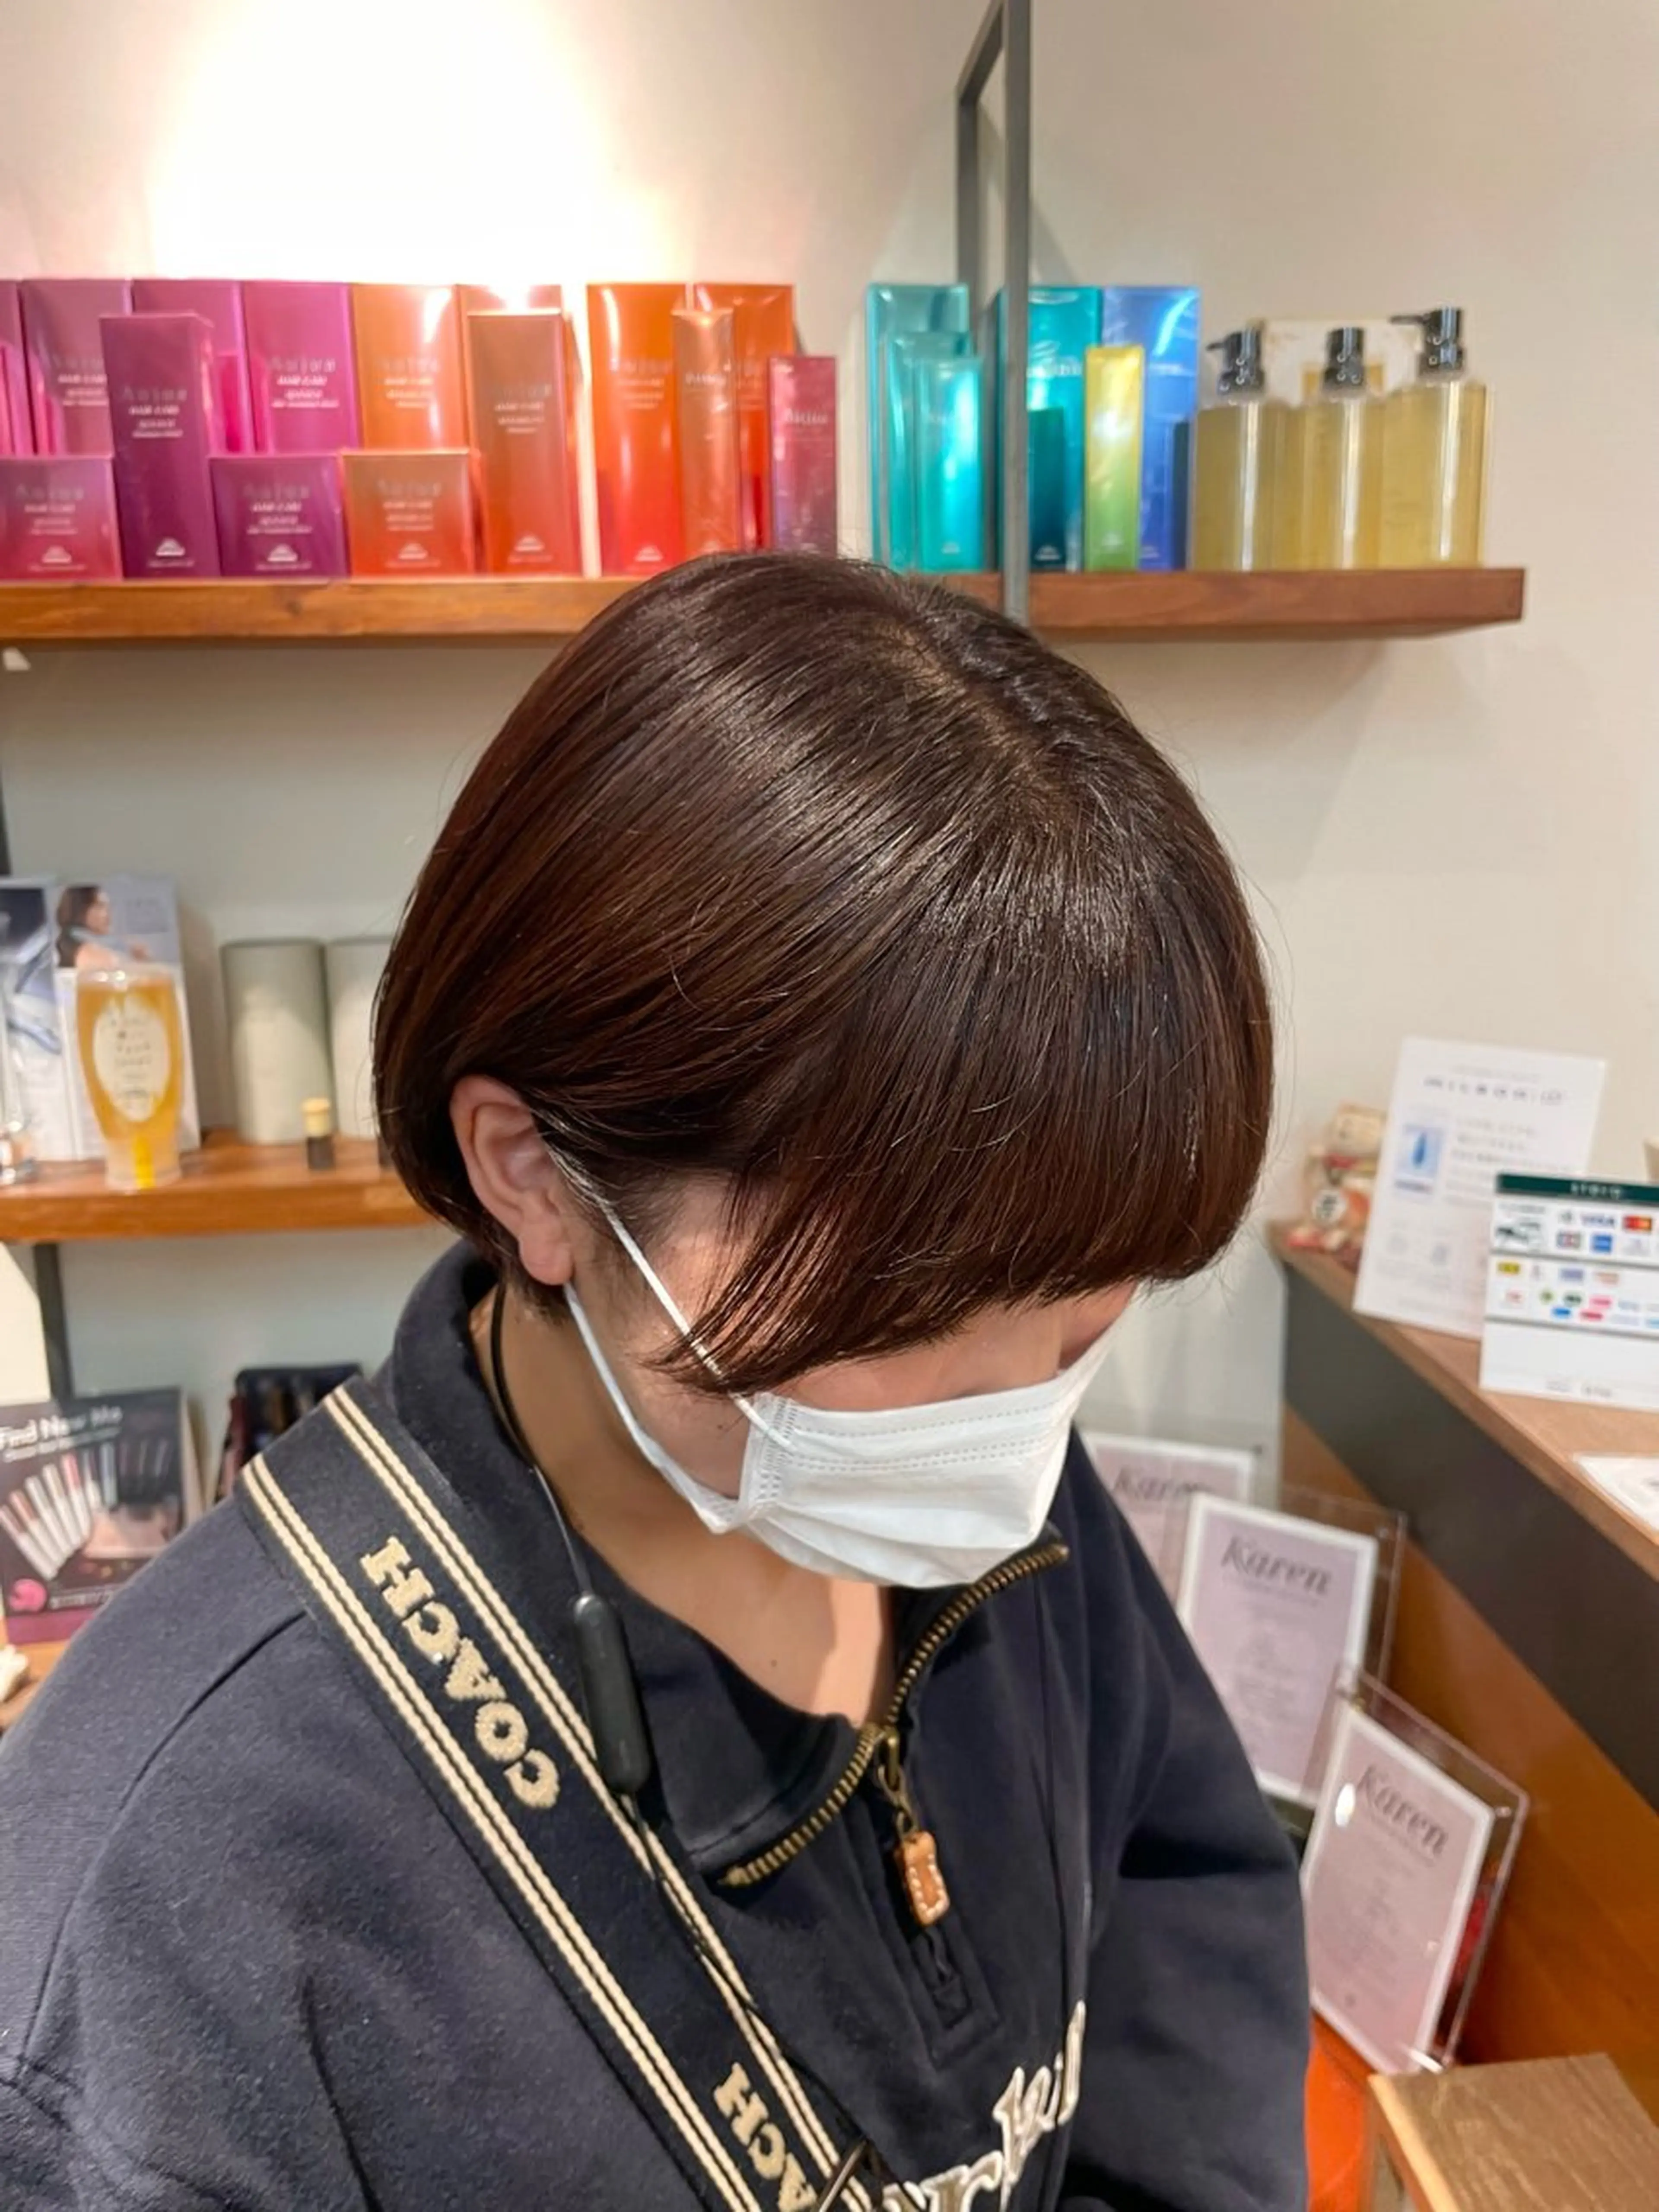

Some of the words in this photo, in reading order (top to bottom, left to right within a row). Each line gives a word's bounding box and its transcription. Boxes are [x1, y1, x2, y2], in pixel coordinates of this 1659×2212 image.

[1221, 1535, 1332, 1595] Karen
[360, 1536, 560, 1809] COACH
[1357, 1763, 1449, 1856] Karen
